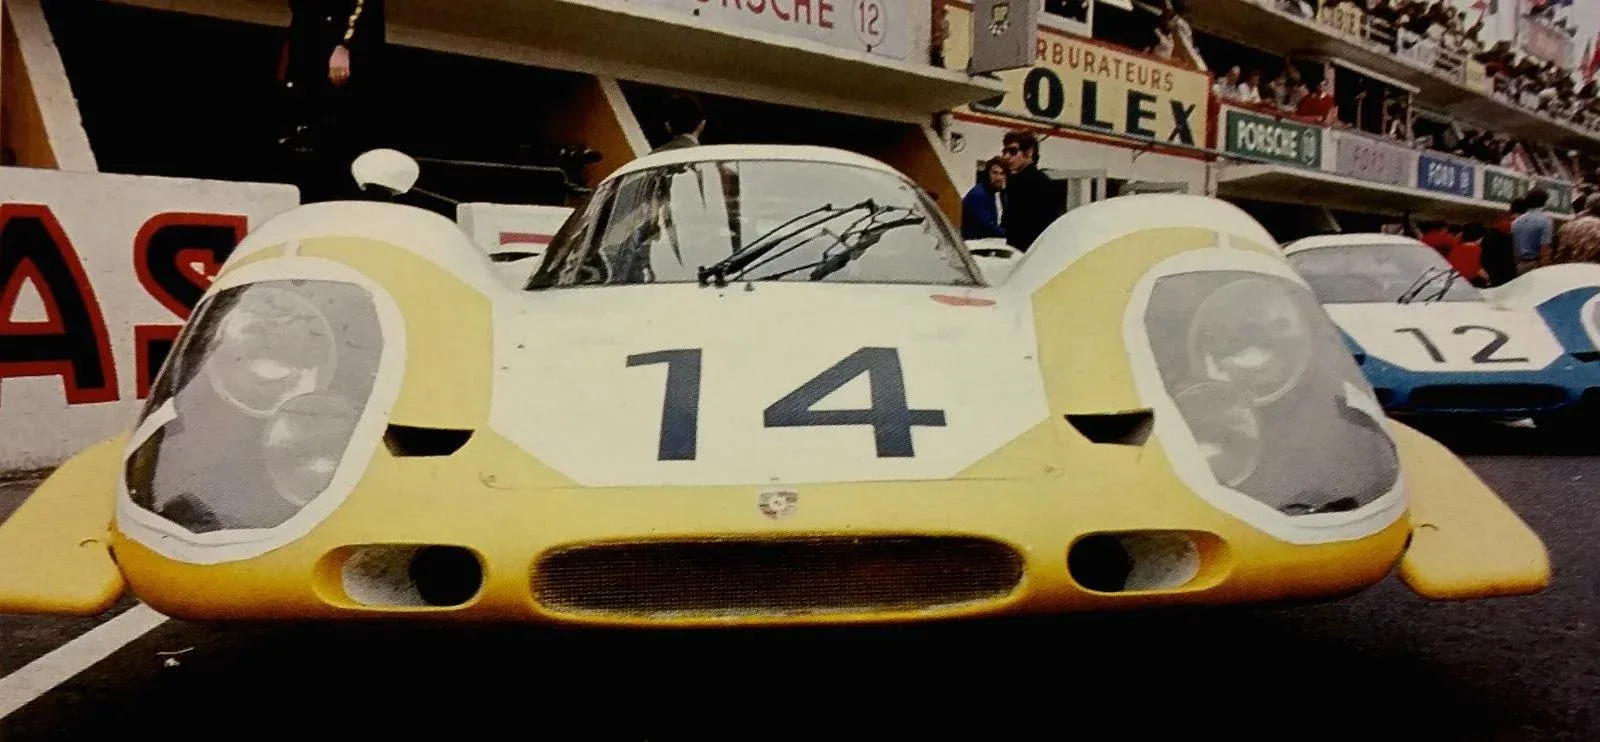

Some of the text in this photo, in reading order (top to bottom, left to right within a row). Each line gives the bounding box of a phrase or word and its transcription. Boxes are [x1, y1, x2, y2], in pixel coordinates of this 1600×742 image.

[860, 2, 880, 35] 12
[968, 66, 1197, 146] OLEX
[1237, 119, 1298, 159] PORSCHE
[1395, 325, 1530, 363] 12
[626, 347, 947, 461] 14
